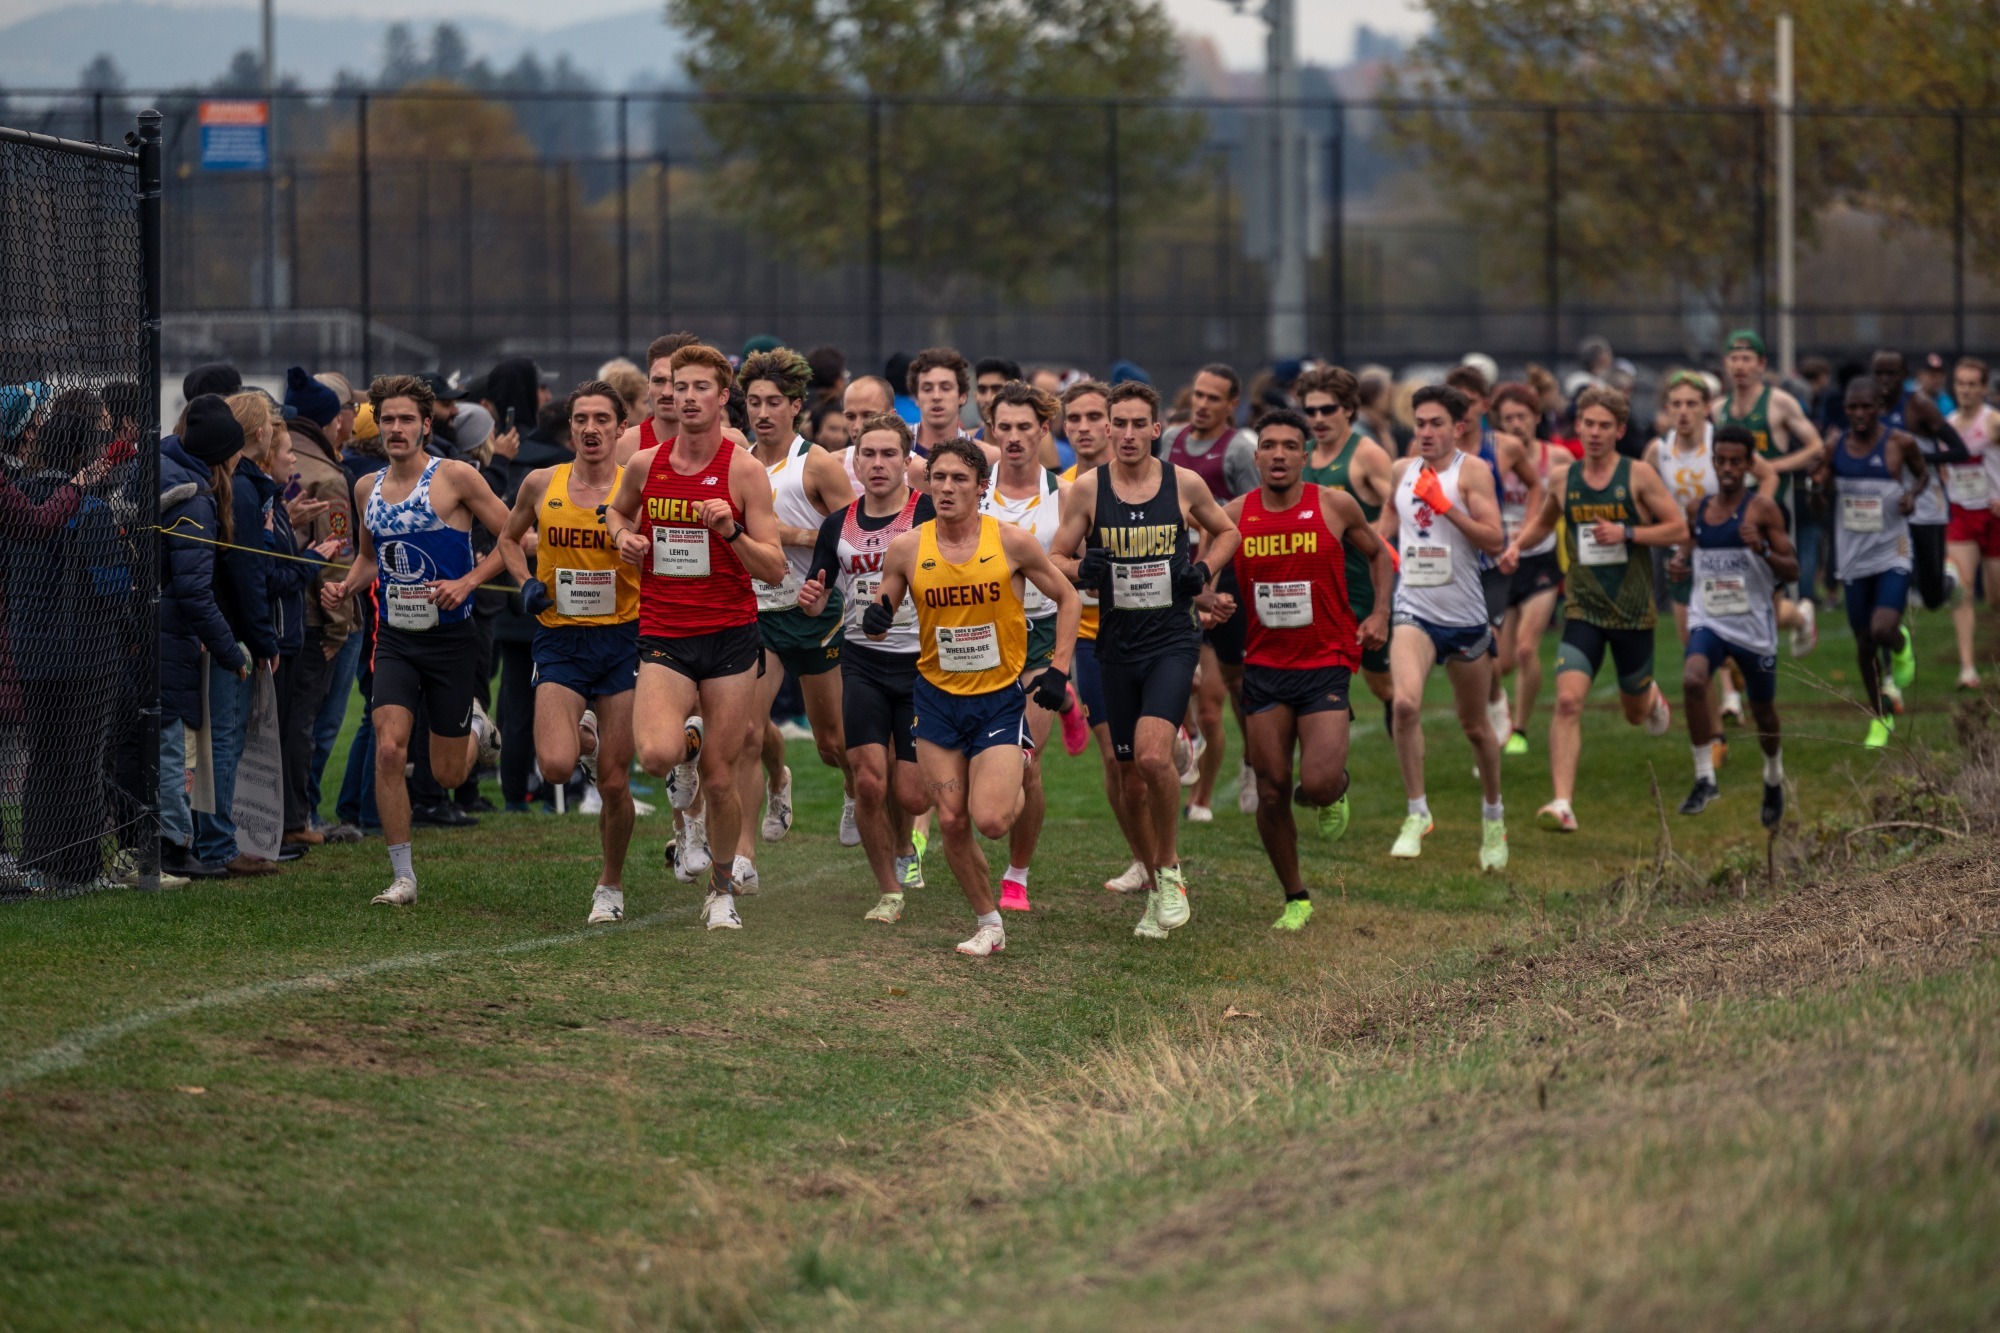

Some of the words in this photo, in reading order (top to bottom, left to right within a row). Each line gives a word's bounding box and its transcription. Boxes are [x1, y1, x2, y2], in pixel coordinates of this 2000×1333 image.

[1099, 524, 1178, 558] DALHOUSIE
[1243, 532, 1317, 558] GUELPH
[925, 581, 1001, 609] QUEEN'S
[1130, 582, 1153, 591] BENOIT
[946, 644, 990, 654] WHEELER-DEE
